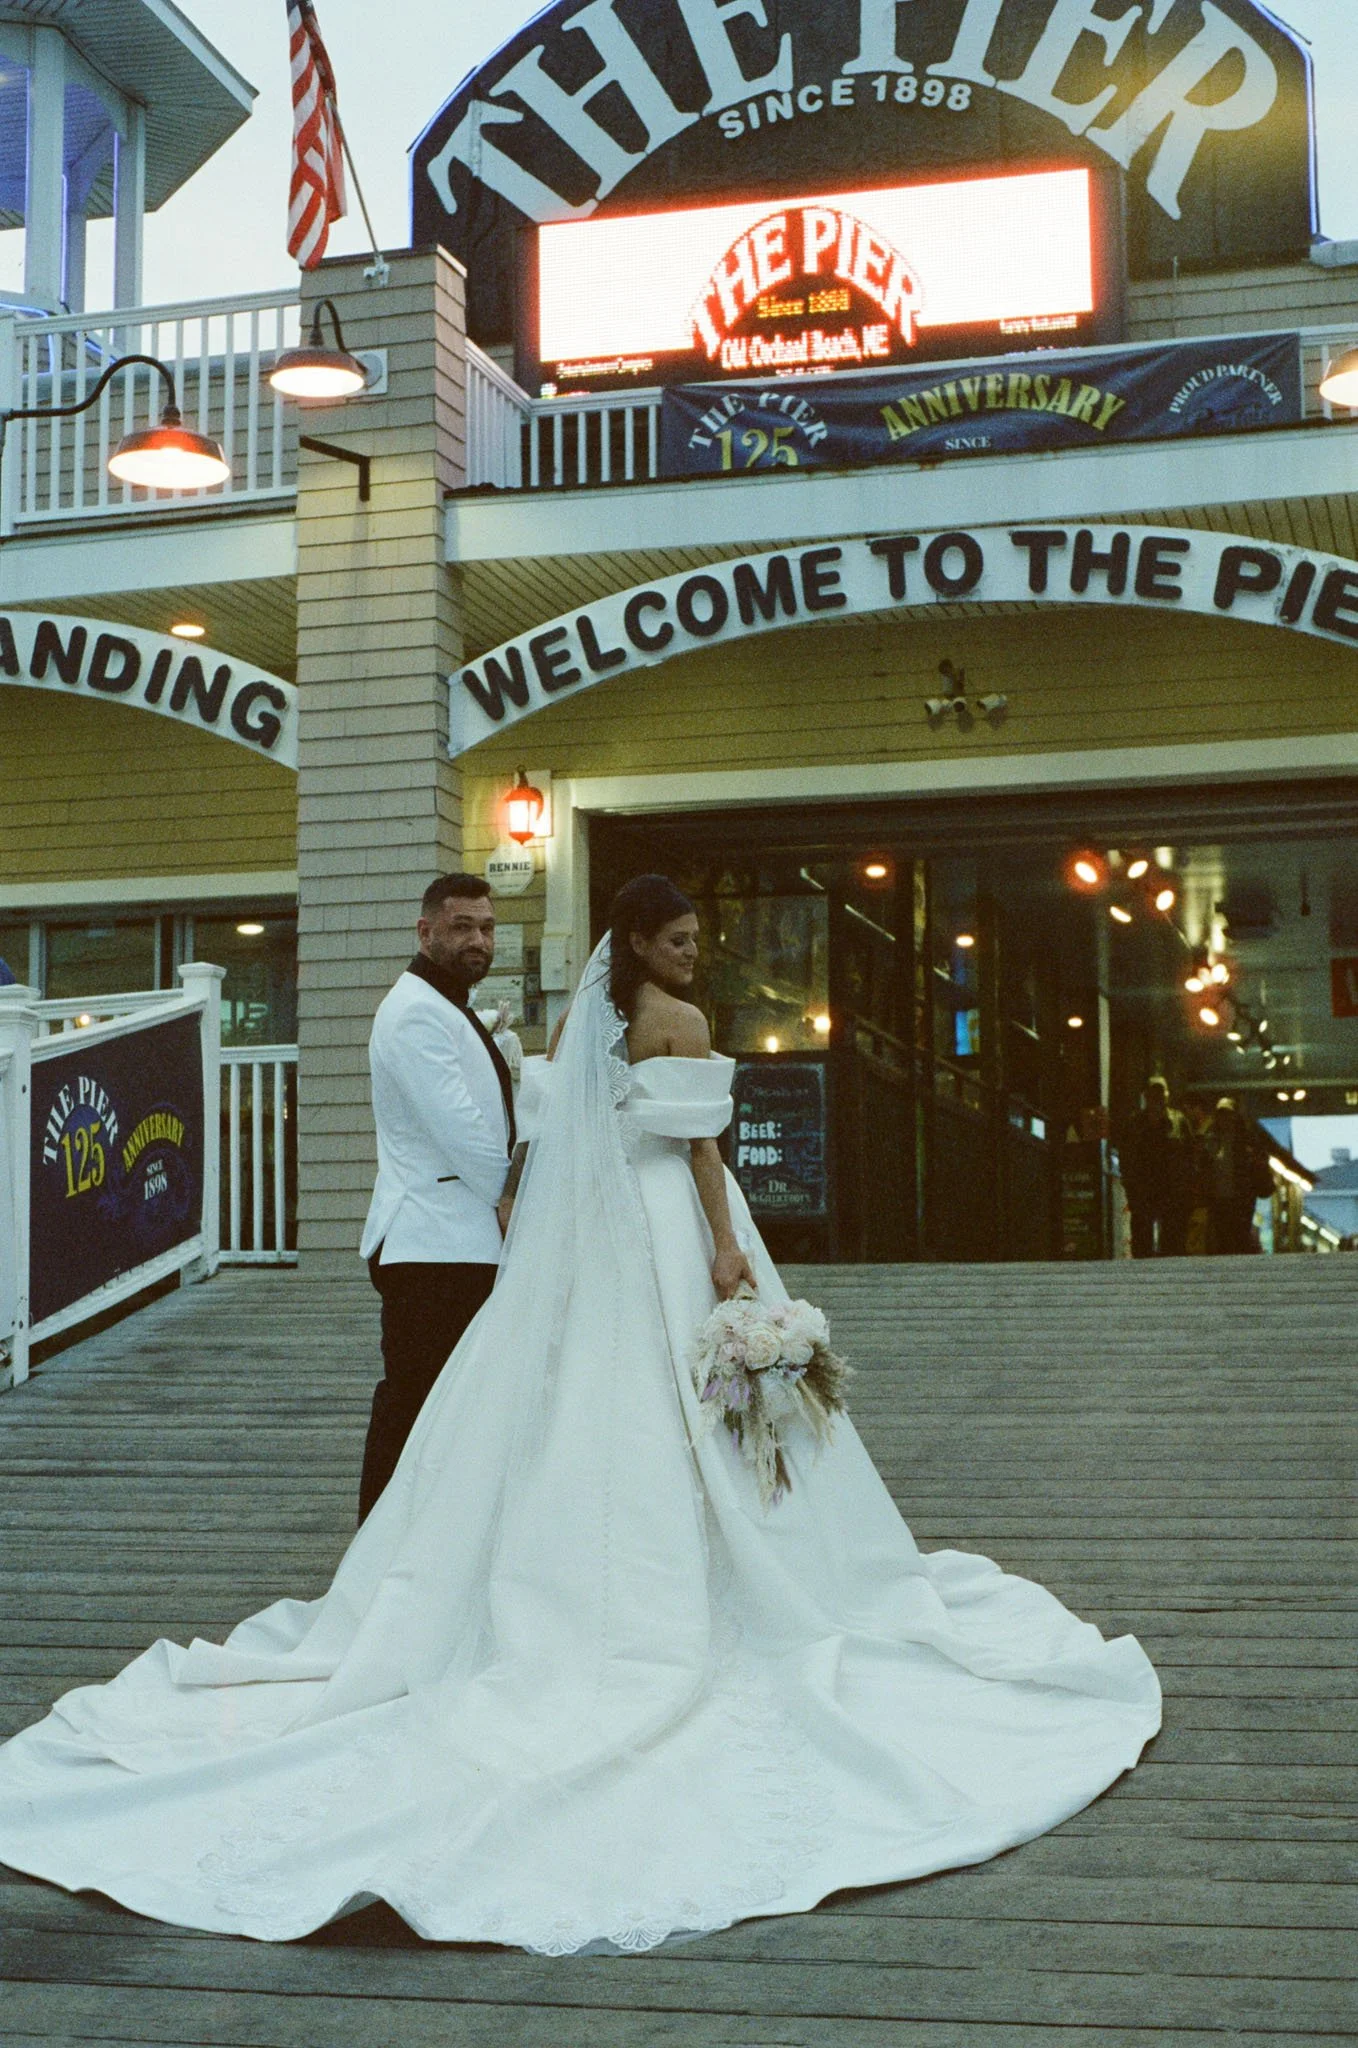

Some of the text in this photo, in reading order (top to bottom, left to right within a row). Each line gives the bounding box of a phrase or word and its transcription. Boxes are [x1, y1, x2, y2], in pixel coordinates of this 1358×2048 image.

[427, 0, 794, 223] THE
[718, 75, 972, 139] SINCE 1898
[690, 206, 923, 360] THE PIER
[721, 337, 747, 370] Old
[879, 372, 1127, 441] ANNIVERSARY
[1168, 364, 1283, 413] PROUD PARTNER
[688, 392, 828, 449] THE PIER
[715, 425, 799, 471] 125
[945, 435, 992, 450] SINCE
[461, 546, 847, 721] WELCOME
[870, 531, 984, 600] TO
[1011, 529, 1191, 598] THE
[43, 1076, 119, 1165] THE PIER
[122, 1113, 185, 1173] ANNIVERSARY
[61, 1121, 105, 1198] 125
[144, 1171, 168, 1200] 1898
[146, 1159, 164, 1175] SINCE
